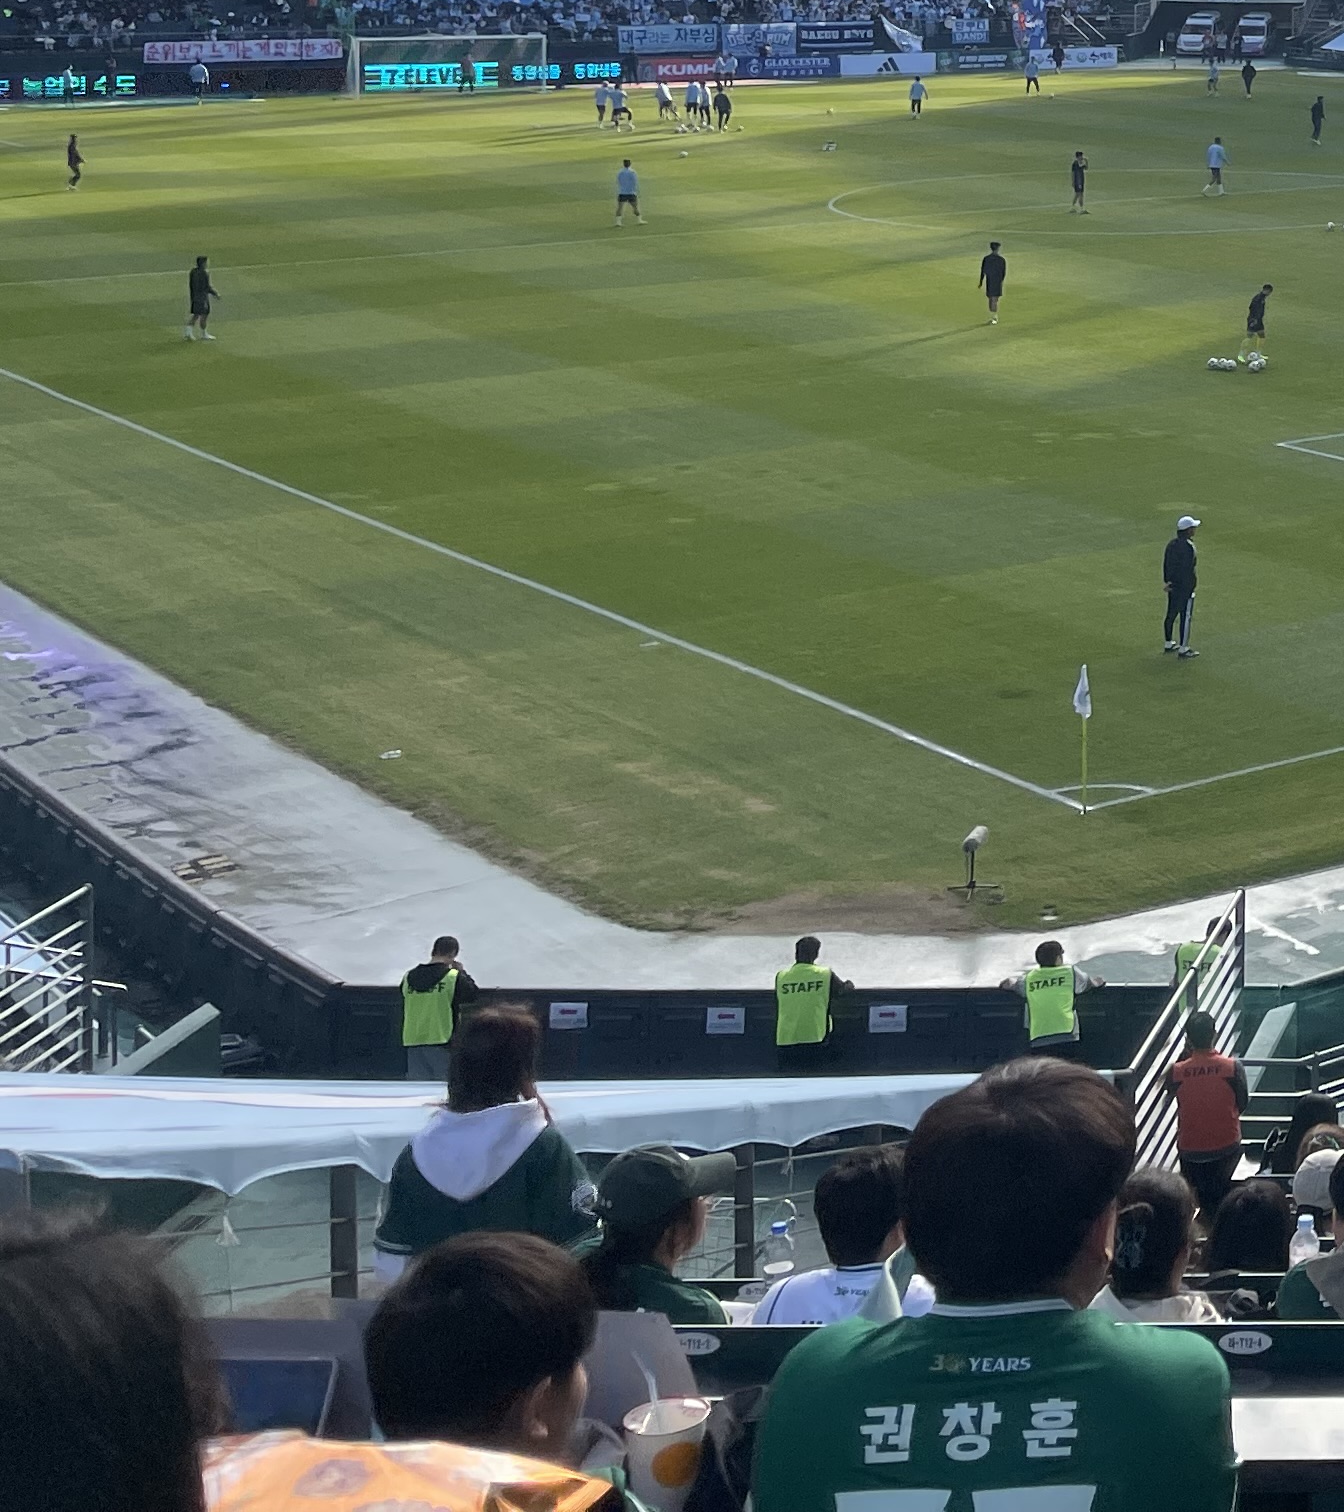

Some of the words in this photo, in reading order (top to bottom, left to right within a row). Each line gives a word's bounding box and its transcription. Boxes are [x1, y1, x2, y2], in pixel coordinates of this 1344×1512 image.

[675, 28, 714, 44] 자부심
[764, 57, 831, 67] GLOUCESTER
[658, 63, 717, 76] KUMH
[1182, 959, 1212, 972] STFF
[782, 980, 824, 994] STAFF
[1028, 976, 1066, 992] STAFF
[1182, 1064, 1220, 1078] STAFF
[968, 1355, 1032, 1373] YEARS
[859, 1397, 1079, 1465] 권창훈
